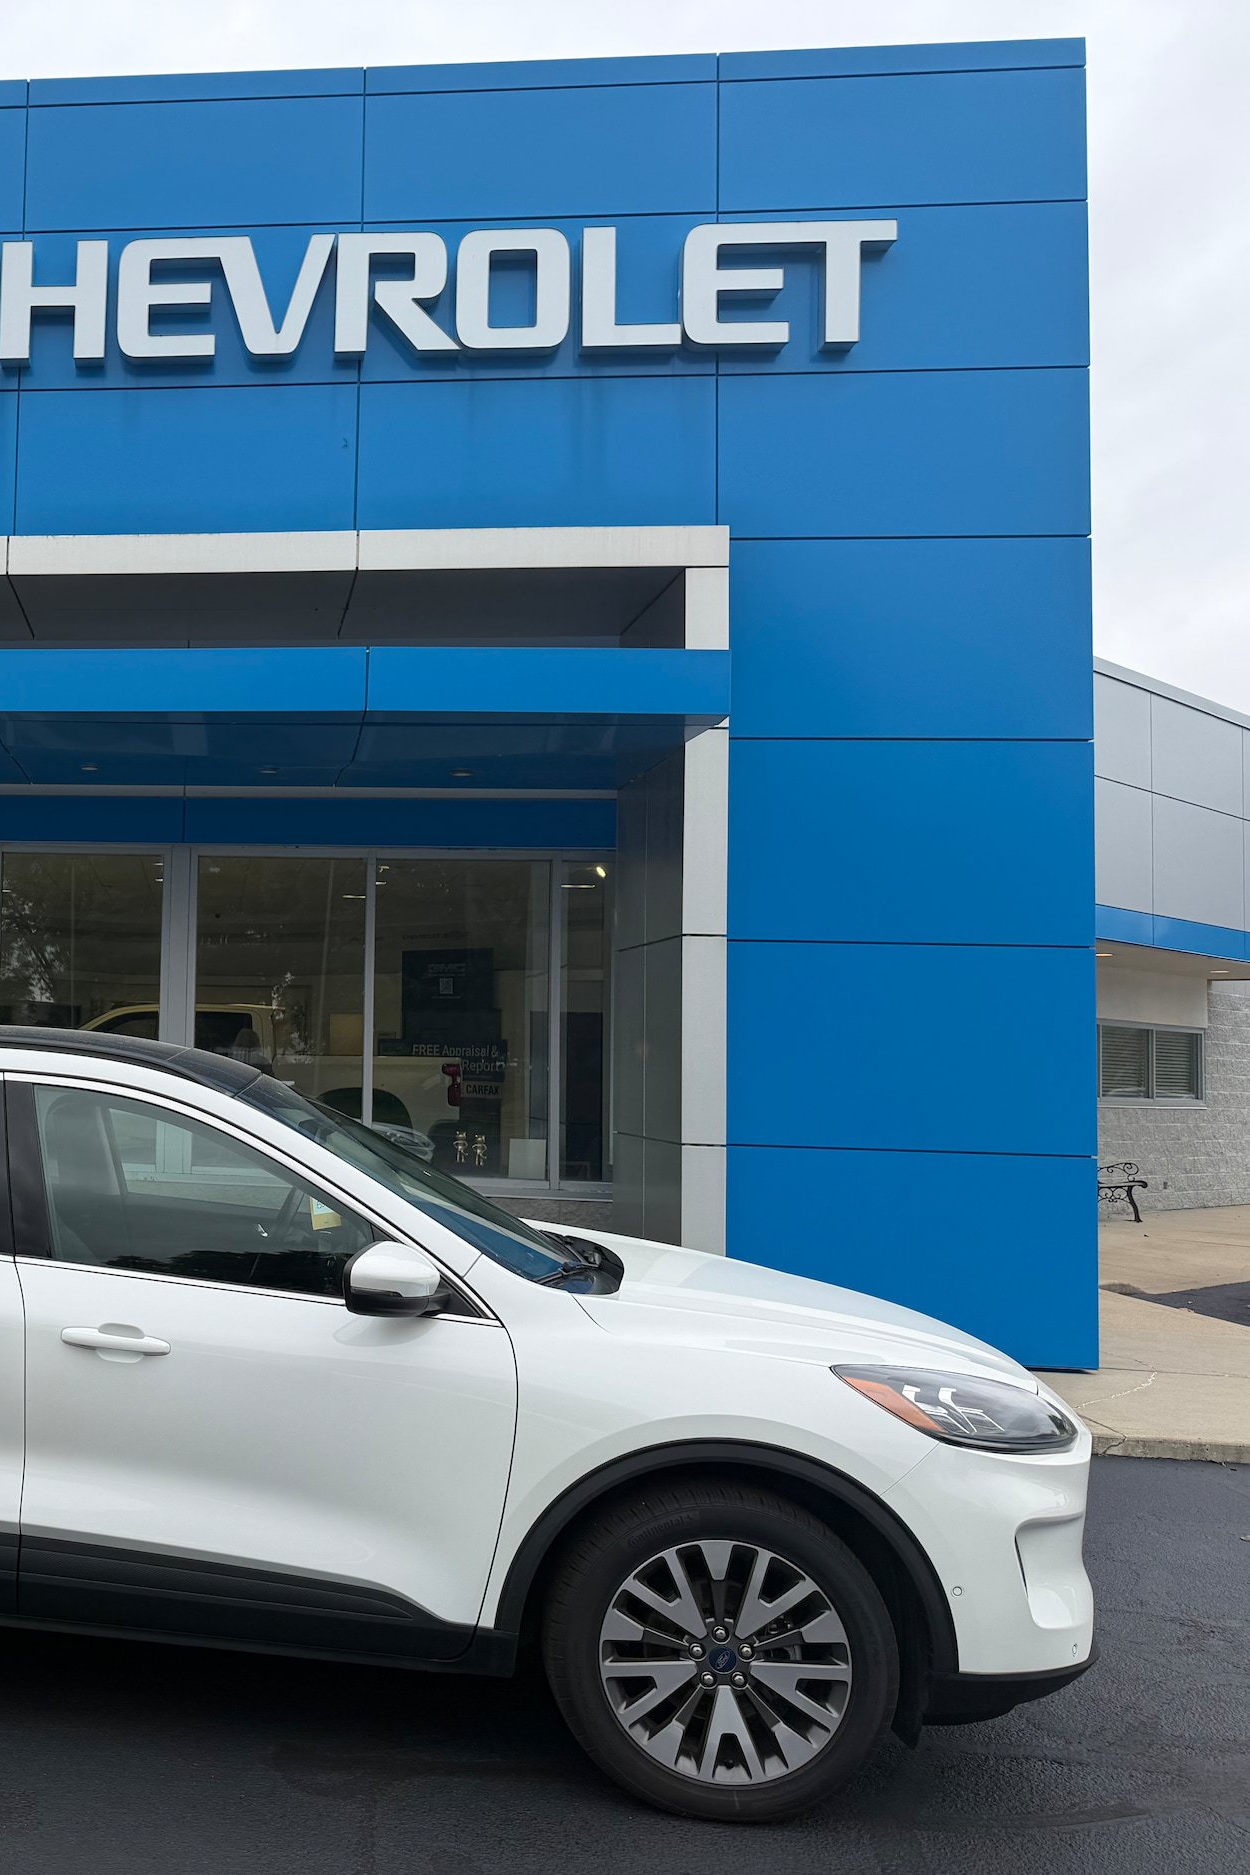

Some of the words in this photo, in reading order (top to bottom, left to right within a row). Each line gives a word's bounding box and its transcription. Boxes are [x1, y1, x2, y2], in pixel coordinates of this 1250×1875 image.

[412, 1044, 440, 1056] FREE
[441, 1044, 490, 1057] Appraisal
[461, 1059, 500, 1074] Report
[466, 1084, 500, 1096] CARFAX
